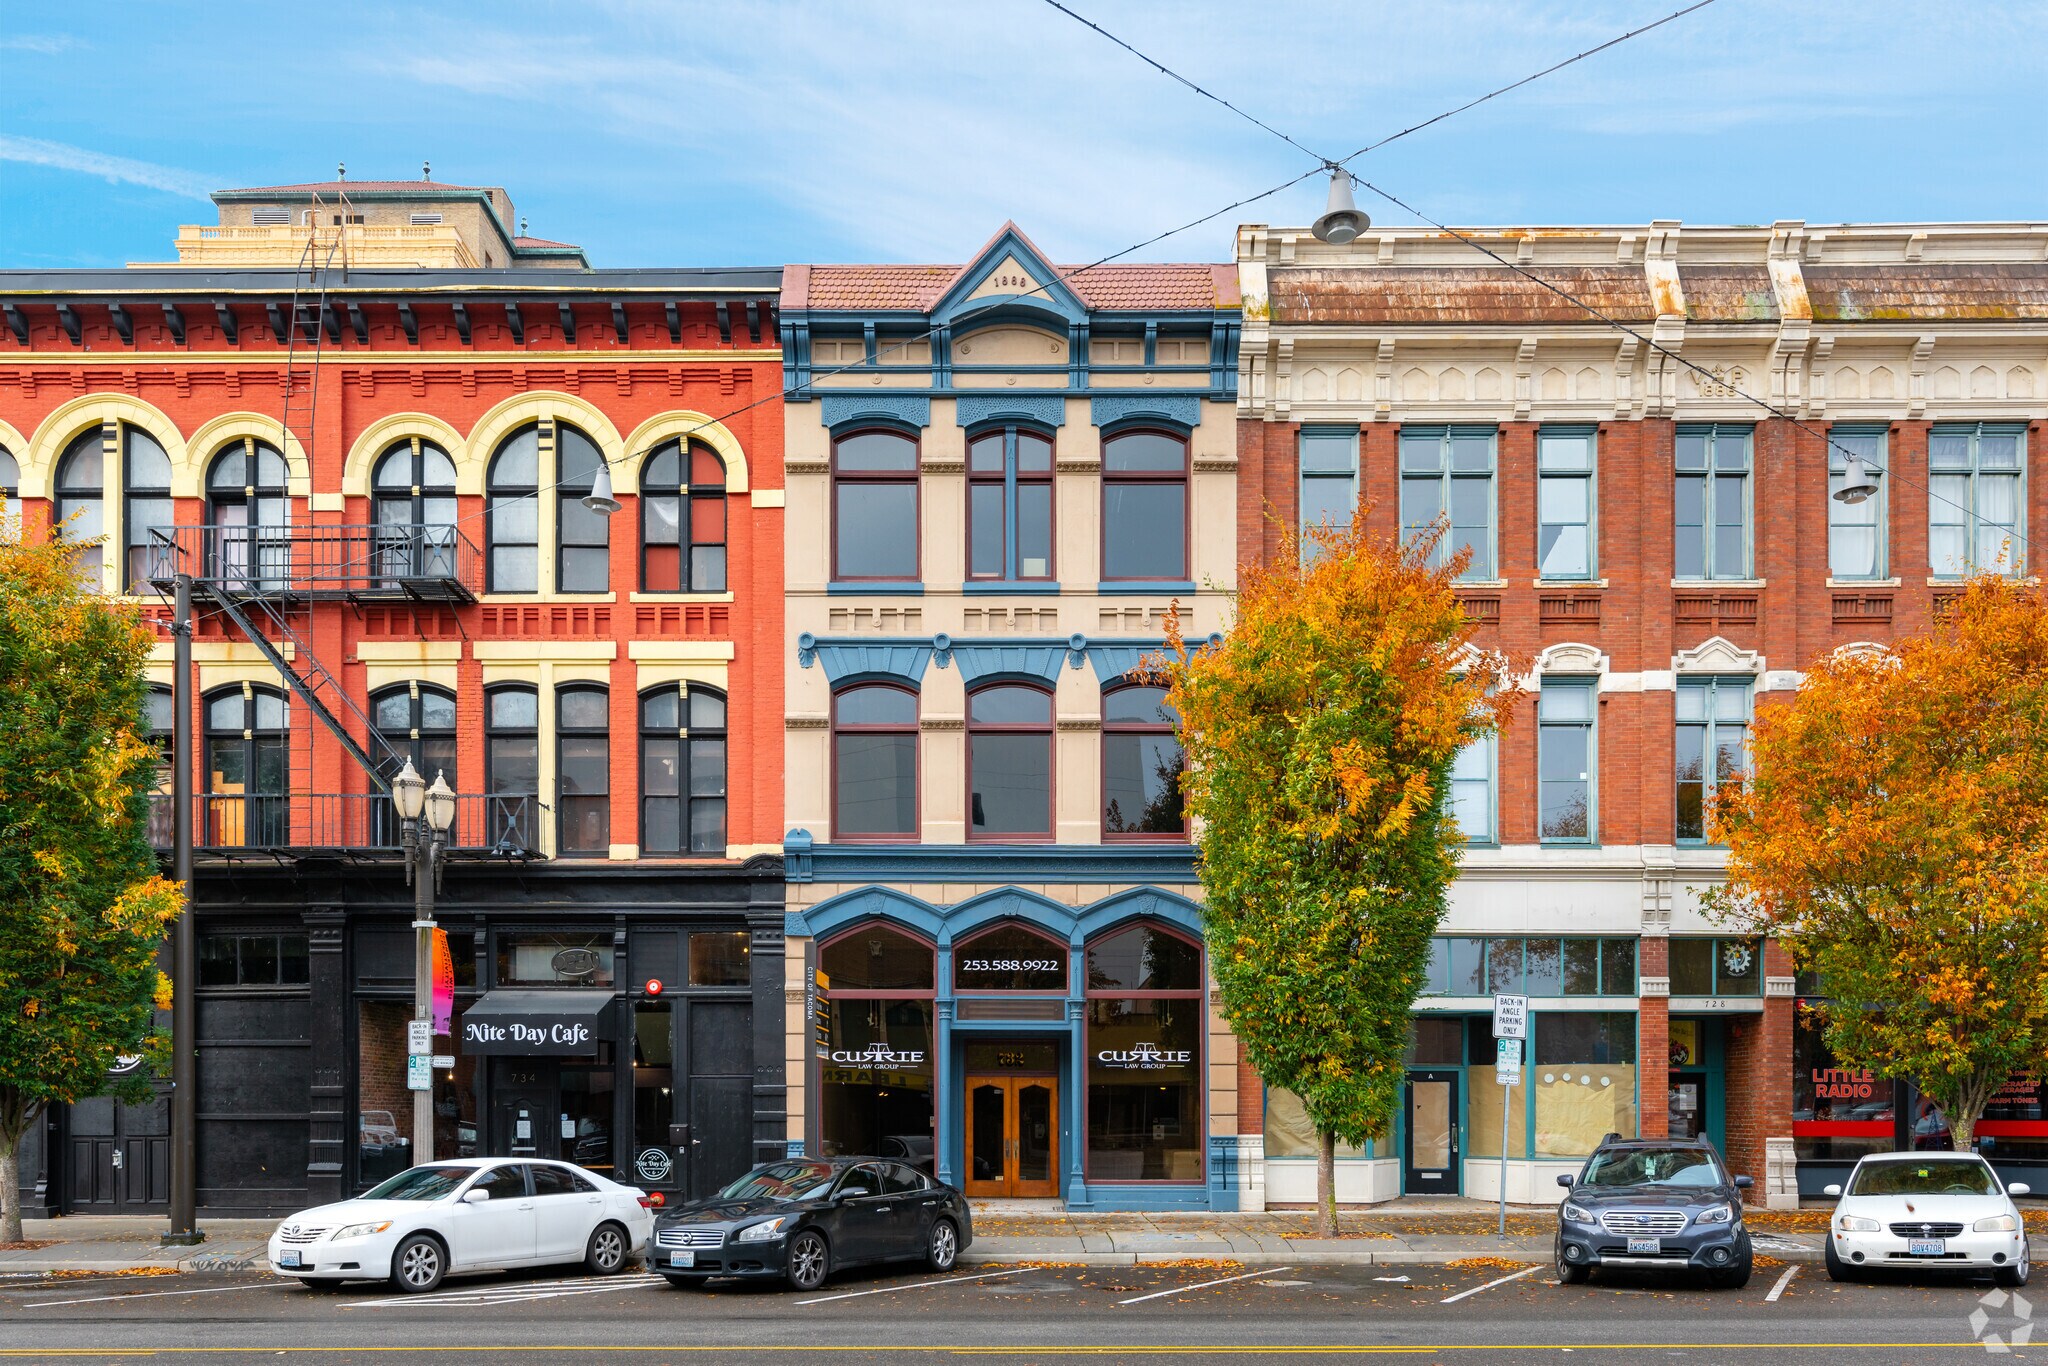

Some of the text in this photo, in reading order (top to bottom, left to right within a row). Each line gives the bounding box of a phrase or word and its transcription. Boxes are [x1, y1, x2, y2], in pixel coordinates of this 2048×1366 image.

[994, 276, 1025, 287] 1888
[963, 960, 1058, 970] 253.588.9922
[808, 984, 813, 992] OF
[1500, 998, 1522, 1006] BACK-IN
[1499, 1017, 1522, 1025] PARKING
[466, 1023, 505, 1042] Nite
[510, 1024, 547, 1045] Day
[552, 1023, 589, 1045] Cafe
[1500, 1041, 1504, 1050] 2
[832, 1051, 924, 1062] CURRIE
[998, 1052, 1025, 1066] 732
[1098, 1050, 1191, 1062] CURRIE
[411, 1058, 416, 1067] 2
[511, 1073, 536, 1083] 734
[1813, 1069, 1874, 1082] LITTLE
[1816, 1084, 1872, 1097] RADIO
